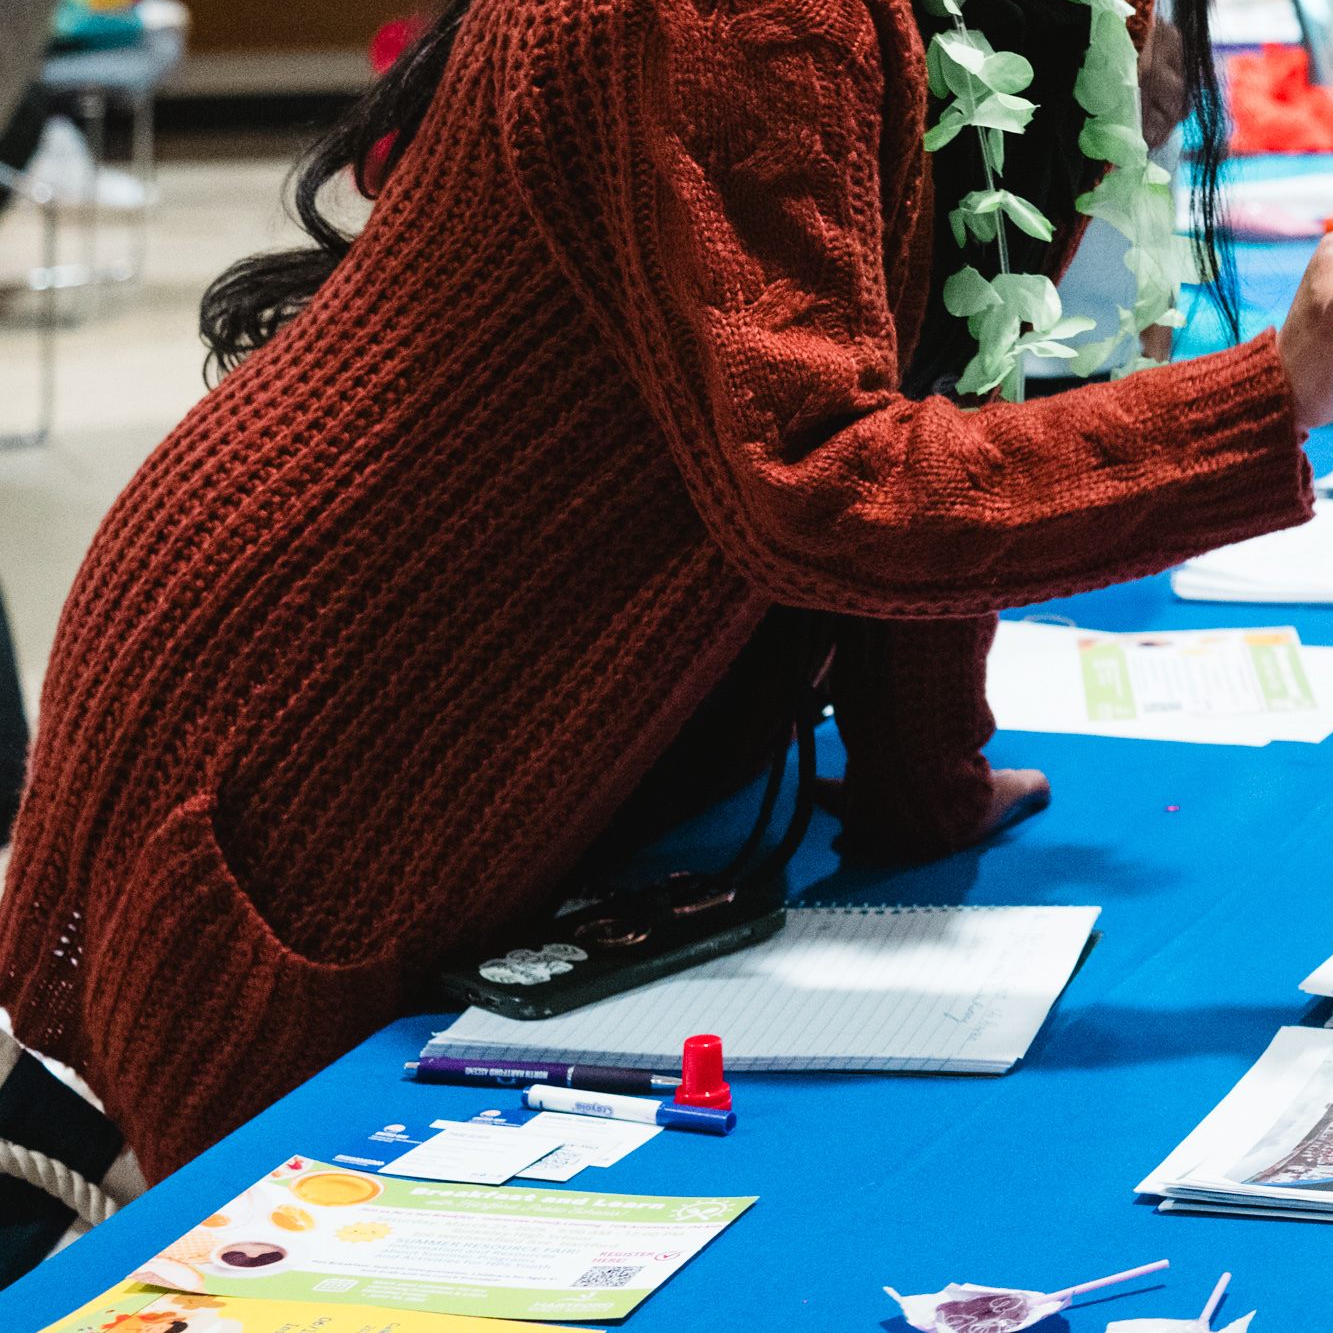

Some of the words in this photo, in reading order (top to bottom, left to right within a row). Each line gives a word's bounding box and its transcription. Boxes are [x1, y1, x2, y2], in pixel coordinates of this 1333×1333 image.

[489, 1067, 524, 1077] HARTFORD
[524, 1069, 547, 1078] NORTH
[575, 1099, 613, 1117] Crayola
[407, 1186, 541, 1202] Breakfast
[537, 1194, 592, 1205] and
[590, 1198, 670, 1210] Learn
[386, 1240, 464, 1254] Information
[393, 1236, 462, 1249] SUMMER
[460, 1240, 539, 1254] RESOURCE
[541, 1246, 582, 1255] FAIR!
[400, 1253, 464, 1265] Activities
[419, 1249, 475, 1260] Summer
